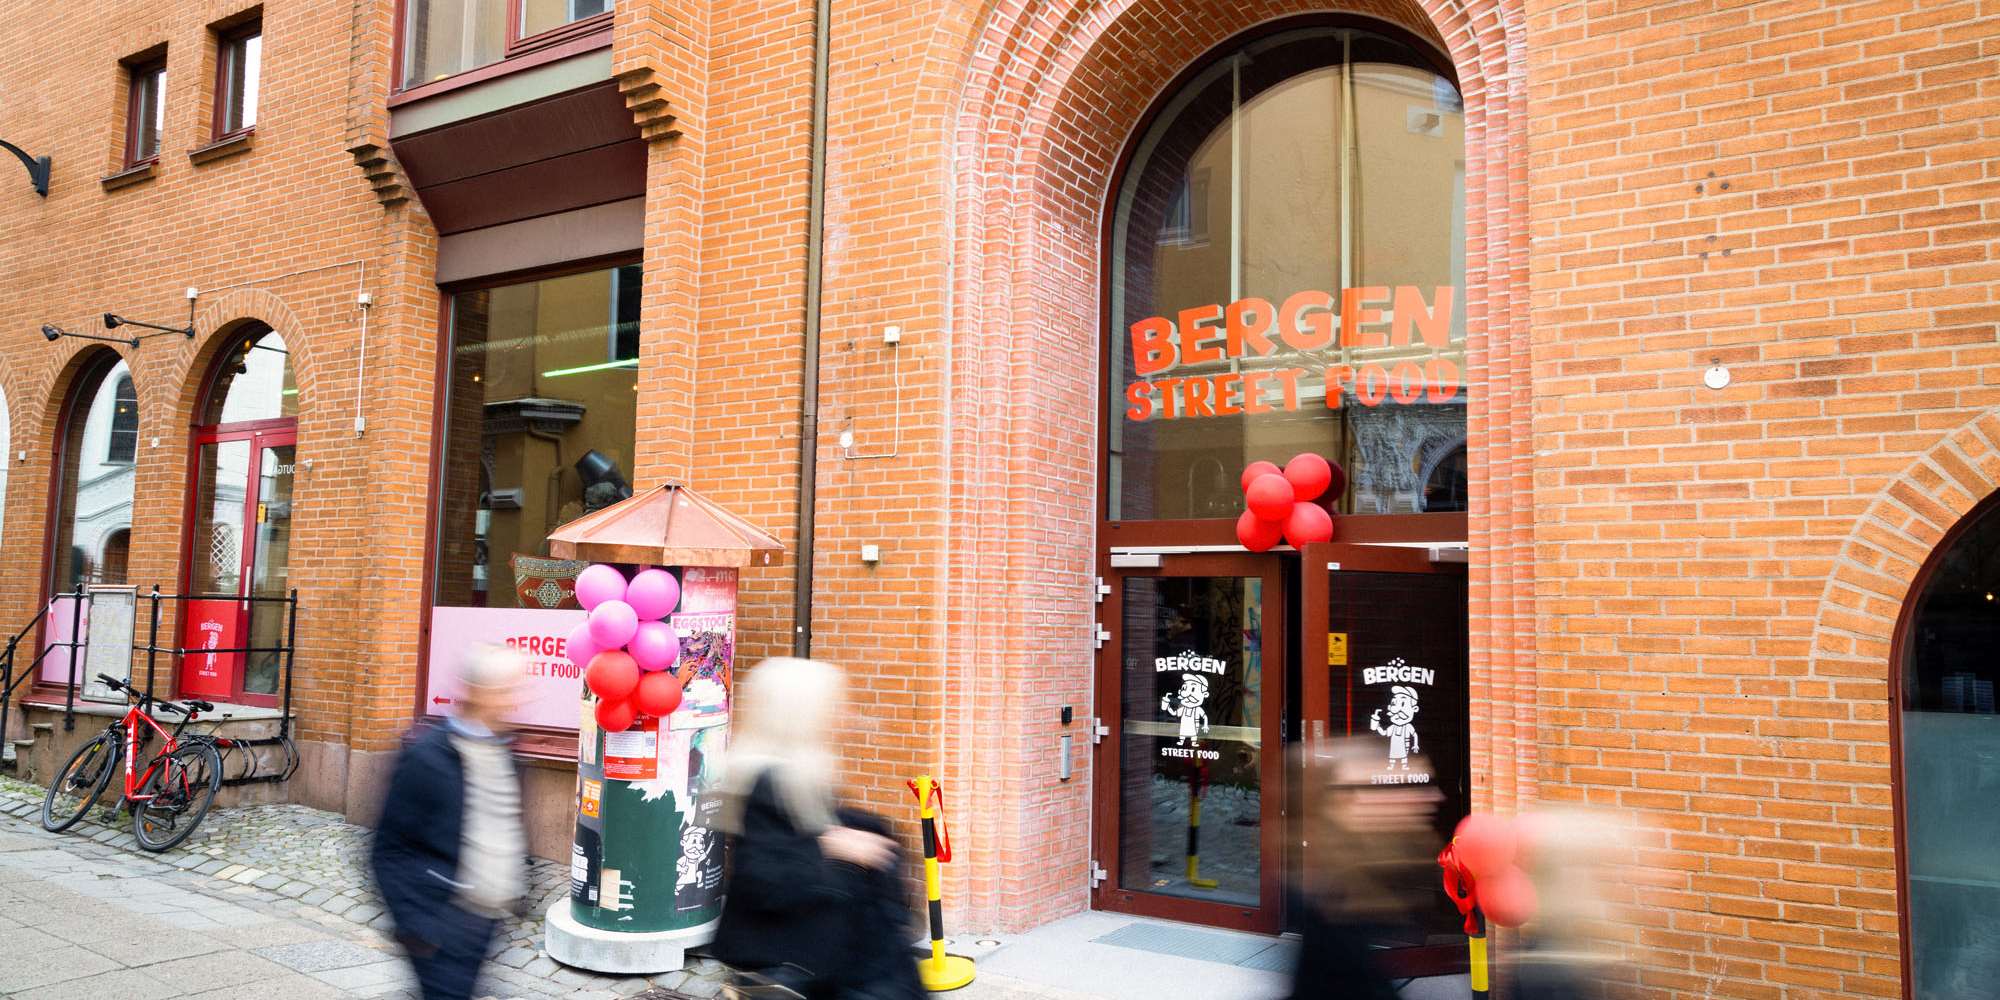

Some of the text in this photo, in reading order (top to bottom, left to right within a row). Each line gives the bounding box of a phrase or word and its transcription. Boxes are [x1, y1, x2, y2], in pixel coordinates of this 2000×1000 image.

[1131, 286, 1455, 376] BERGEN
[1126, 358, 1459, 422] STREET FOOD
[505, 636, 569, 658] BERGE
[551, 664, 580, 678] FOOD
[1155, 655, 1227, 676] BERGEN
[1363, 665, 1435, 686] BERGEN
[1161, 747, 1220, 761] STREET FOOD
[1370, 772, 1430, 785] STREET FOOD
